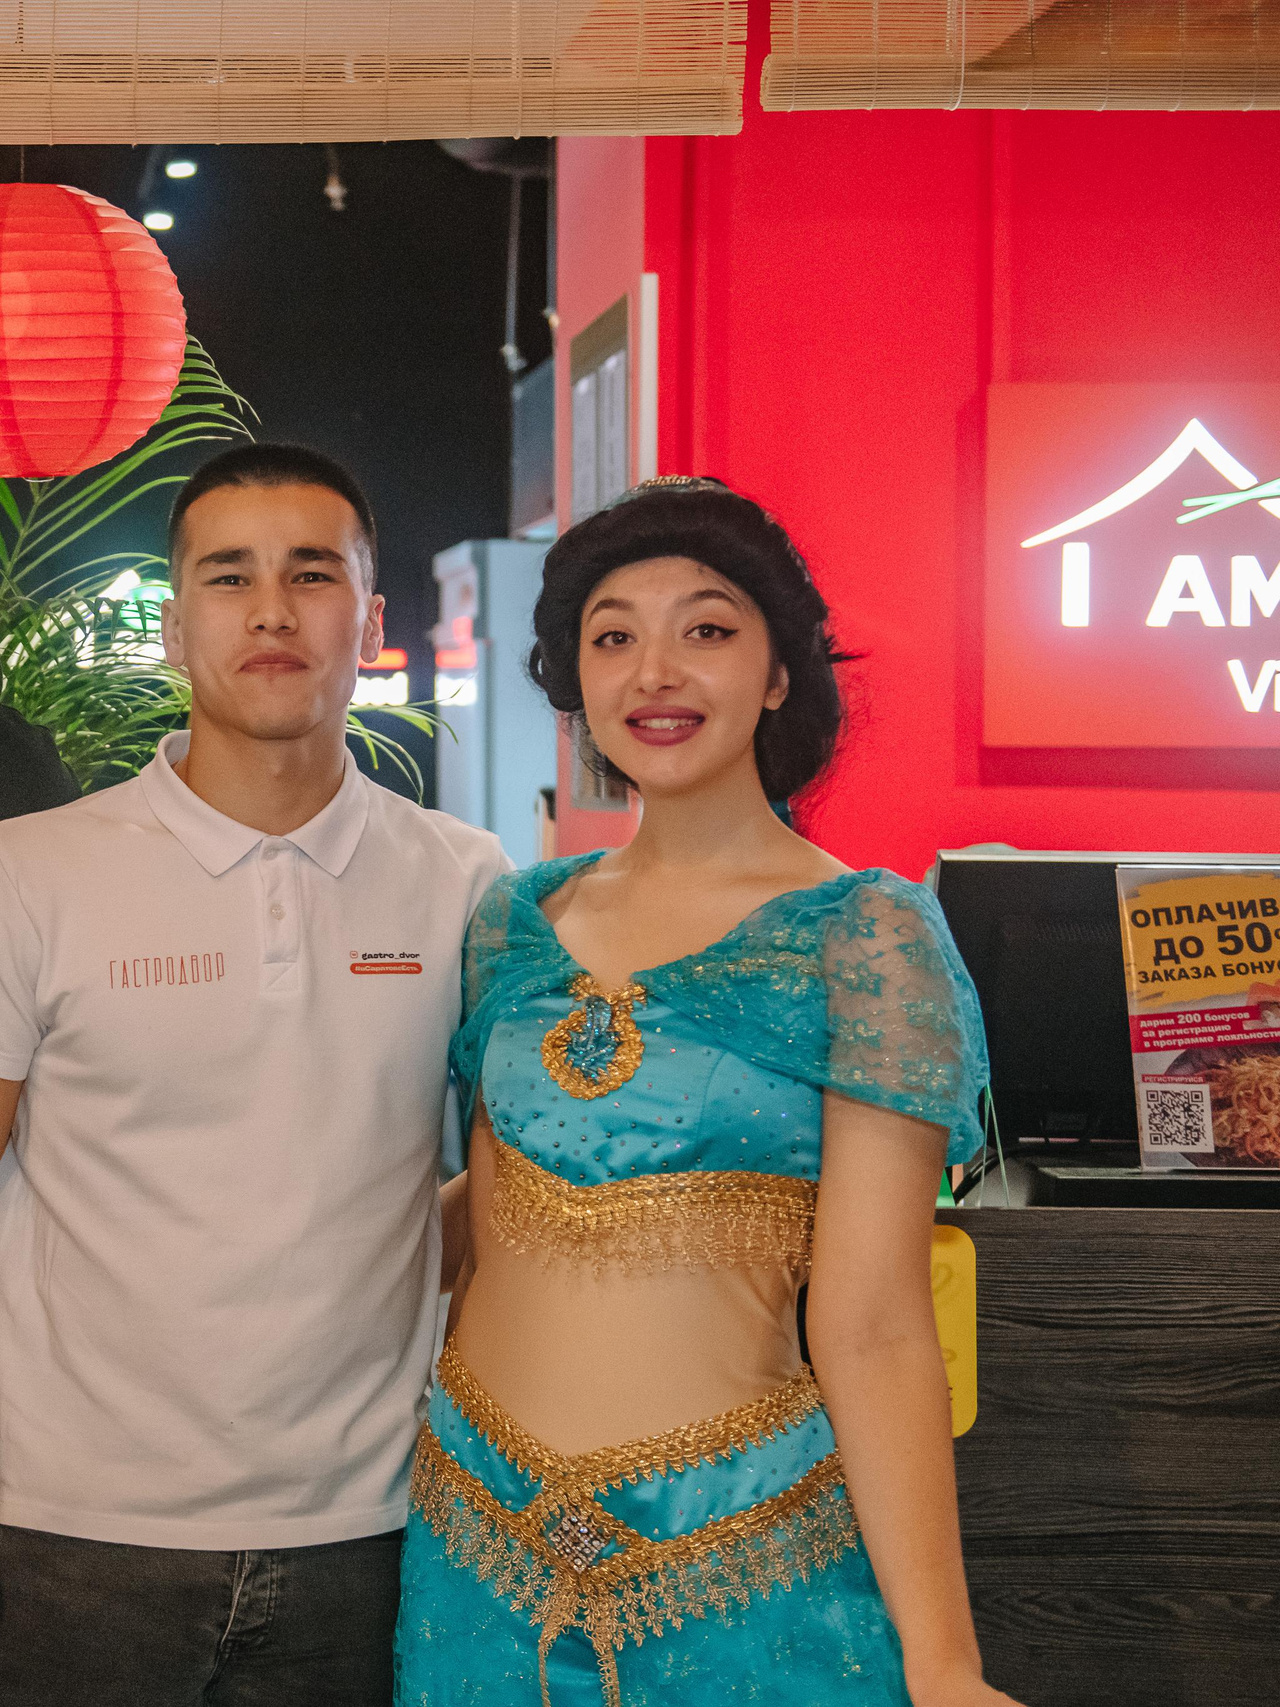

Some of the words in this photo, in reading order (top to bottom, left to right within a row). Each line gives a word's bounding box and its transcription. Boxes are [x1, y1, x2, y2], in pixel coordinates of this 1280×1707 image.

[1061, 541, 1090, 627] I
[1145, 554, 1280, 627] AM
[1131, 897, 1280, 928] ОПЛАЧИВ
[361, 951, 421, 961] gastro_dvor
[1153, 935, 1205, 966] ДО
[109, 952, 225, 989] ГАСТРОДВОР
[1138, 965, 1217, 984] ЗАКАЗА
[1140, 1017, 1175, 1028] дарим
[1177, 1013, 1202, 1024] 200
[1204, 1012, 1250, 1022] бонусов
[1142, 1030, 1155, 1038] за
[1158, 1024, 1231, 1038] регистрацию
[1144, 1040, 1150, 1048] в
[1153, 1035, 1214, 1048] программе
